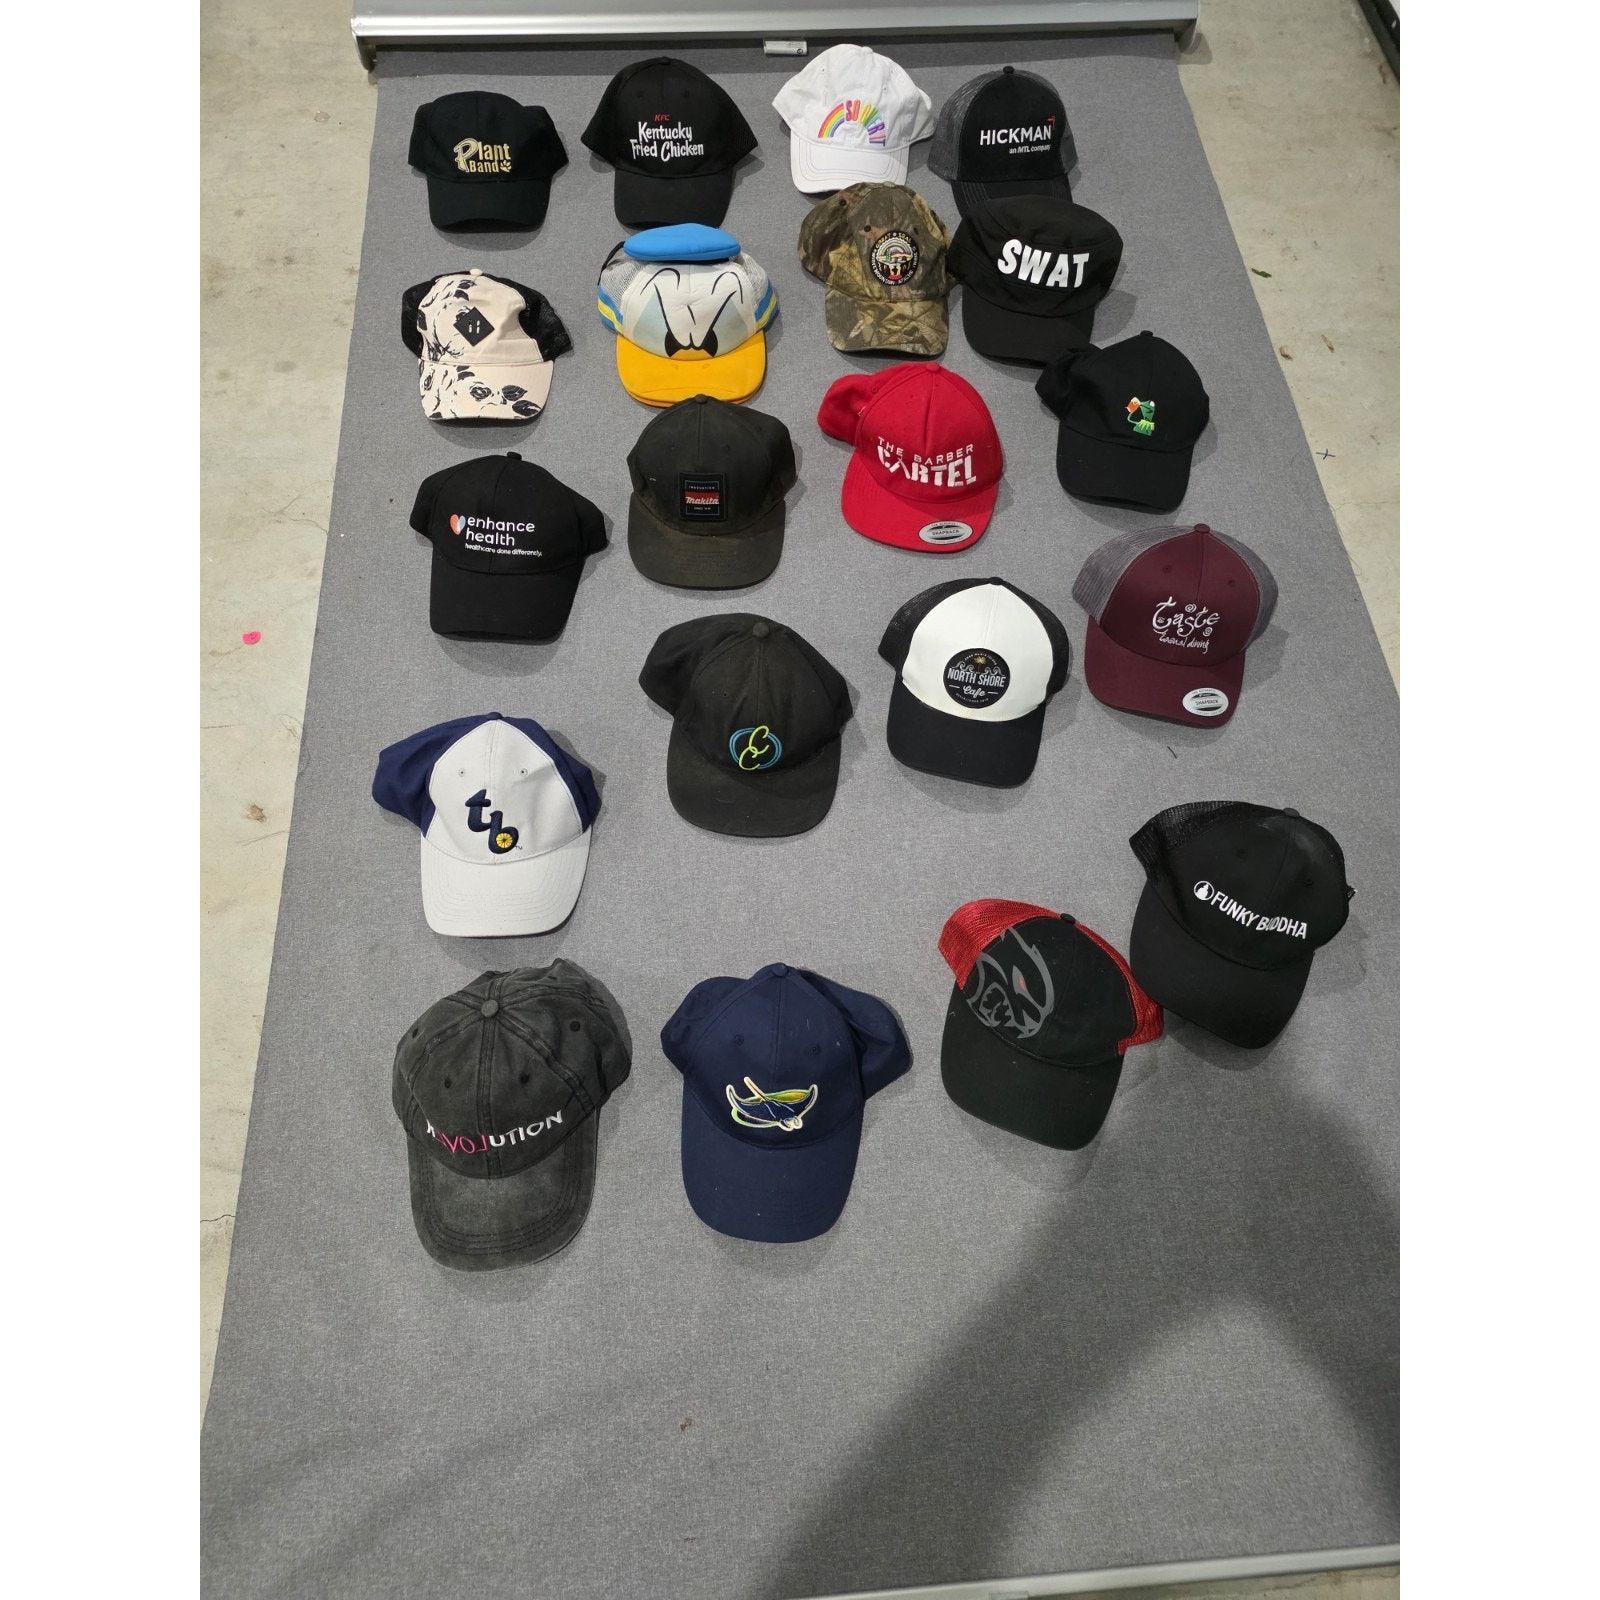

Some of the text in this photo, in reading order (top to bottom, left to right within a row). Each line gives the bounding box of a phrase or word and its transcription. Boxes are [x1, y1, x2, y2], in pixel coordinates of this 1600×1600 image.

[638, 121, 693, 142] Kentucky
[980, 125, 1051, 146] HICKMAN
[453, 137, 512, 173] Plant
[629, 138, 704, 162] Fried Chicken
[997, 238, 1090, 288] SWAT
[878, 436, 974, 465] THE BARBER
[877, 445, 977, 487] CARTEL
[467, 516, 535, 532] enhance
[465, 527, 515, 546] health
[947, 667, 1007, 688] NORTH SHORE
[962, 685, 986, 699] Cafe
[1210, 891, 1260, 927] FUNKY
